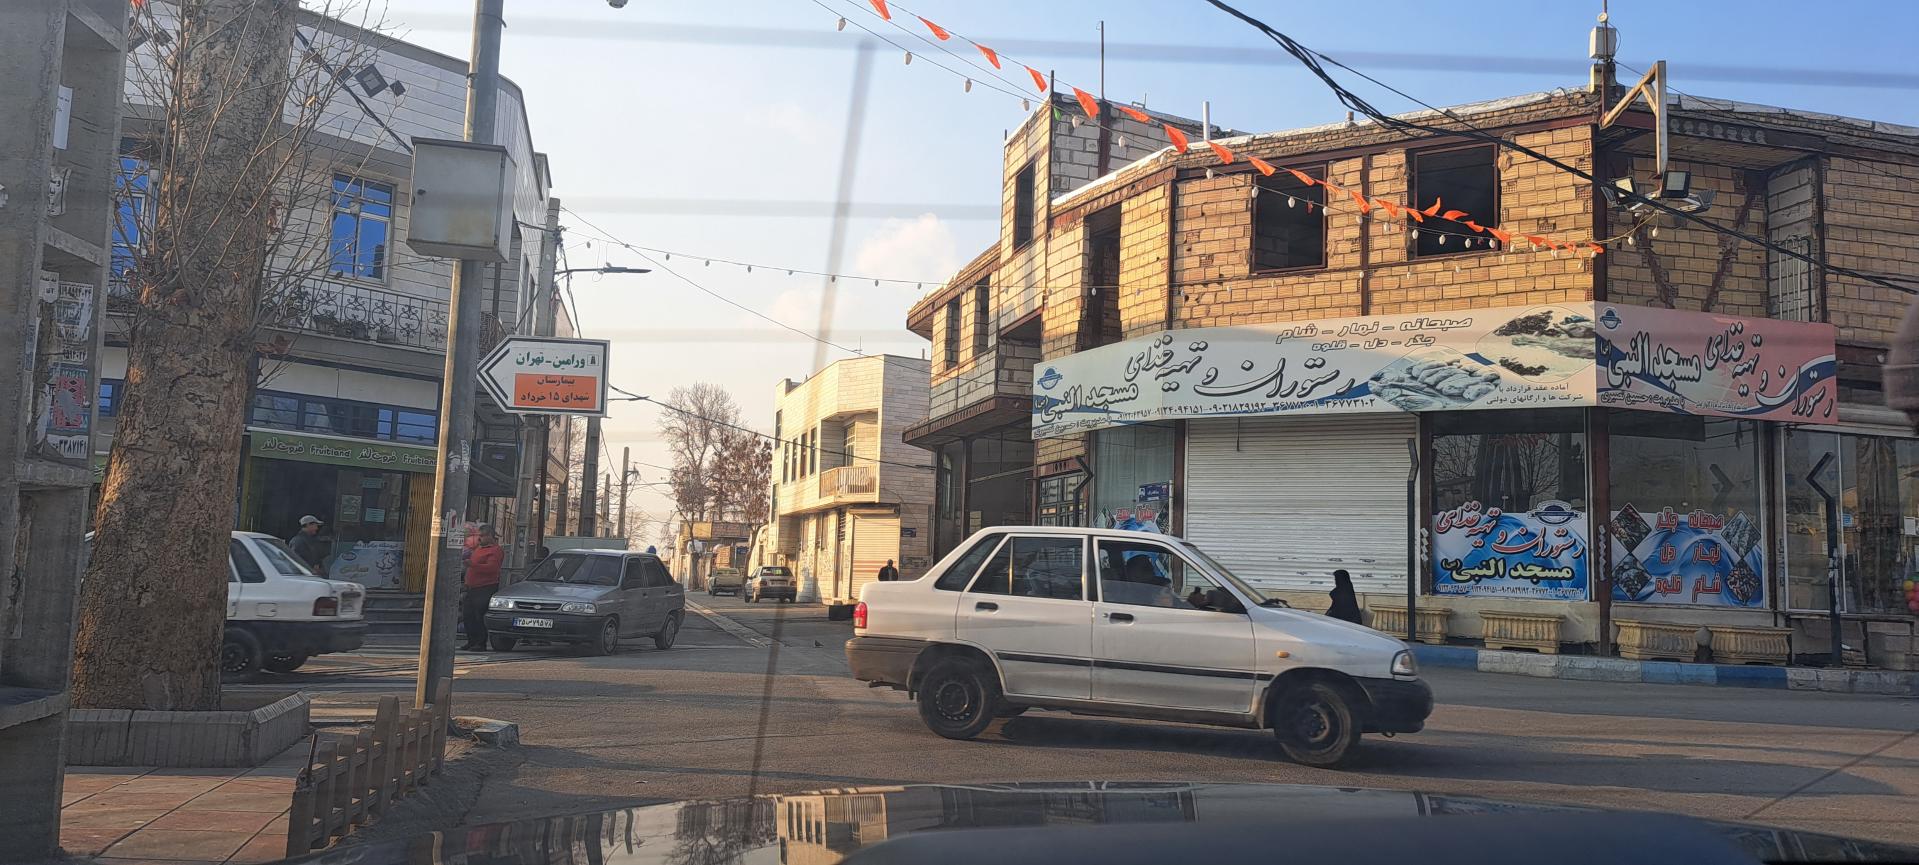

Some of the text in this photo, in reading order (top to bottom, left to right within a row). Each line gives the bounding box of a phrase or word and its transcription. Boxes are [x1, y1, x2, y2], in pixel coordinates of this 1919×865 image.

[1276, 323, 1318, 344] شام
[1337, 321, 1379, 337] نهار
[1400, 317, 1473, 331] صبحانه
[1312, 340, 1347, 352] قلوه
[1364, 338, 1388, 350] دل
[1405, 334, 1436, 347] جگر
[1704, 321, 1745, 371] غذای
[1124, 335, 1173, 382] غذای
[1155, 340, 1209, 392] تهیه
[1606, 330, 1651, 389] النبی
[1652, 343, 1702, 390] مسجد
[1731, 334, 1763, 397] تهیه
[536, 375, 576, 387] بیمارستان
[1194, 357, 1355, 398] رستوران
[1202, 367, 1219, 386] و
[1759, 370, 1769, 391] و
[521, 391, 590, 403] شهدای ۱۵ خرداد
[1086, 383, 1139, 412] مسجد
[1505, 384, 1531, 394] قرارداد
[1533, 384, 1549, 392] عقد
[1558, 393, 1584, 402] شرکت
[1755, 365, 1833, 418] رستوران
[1040, 384, 1082, 424] النبی
[1486, 395, 1508, 405] دولتی
[1435, 501, 1584, 559] رستوران و تهیه غذای
[1451, 556, 1507, 583] النبی
[1509, 560, 1576, 584] مسجد
[1691, 572, 1723, 603] شام
